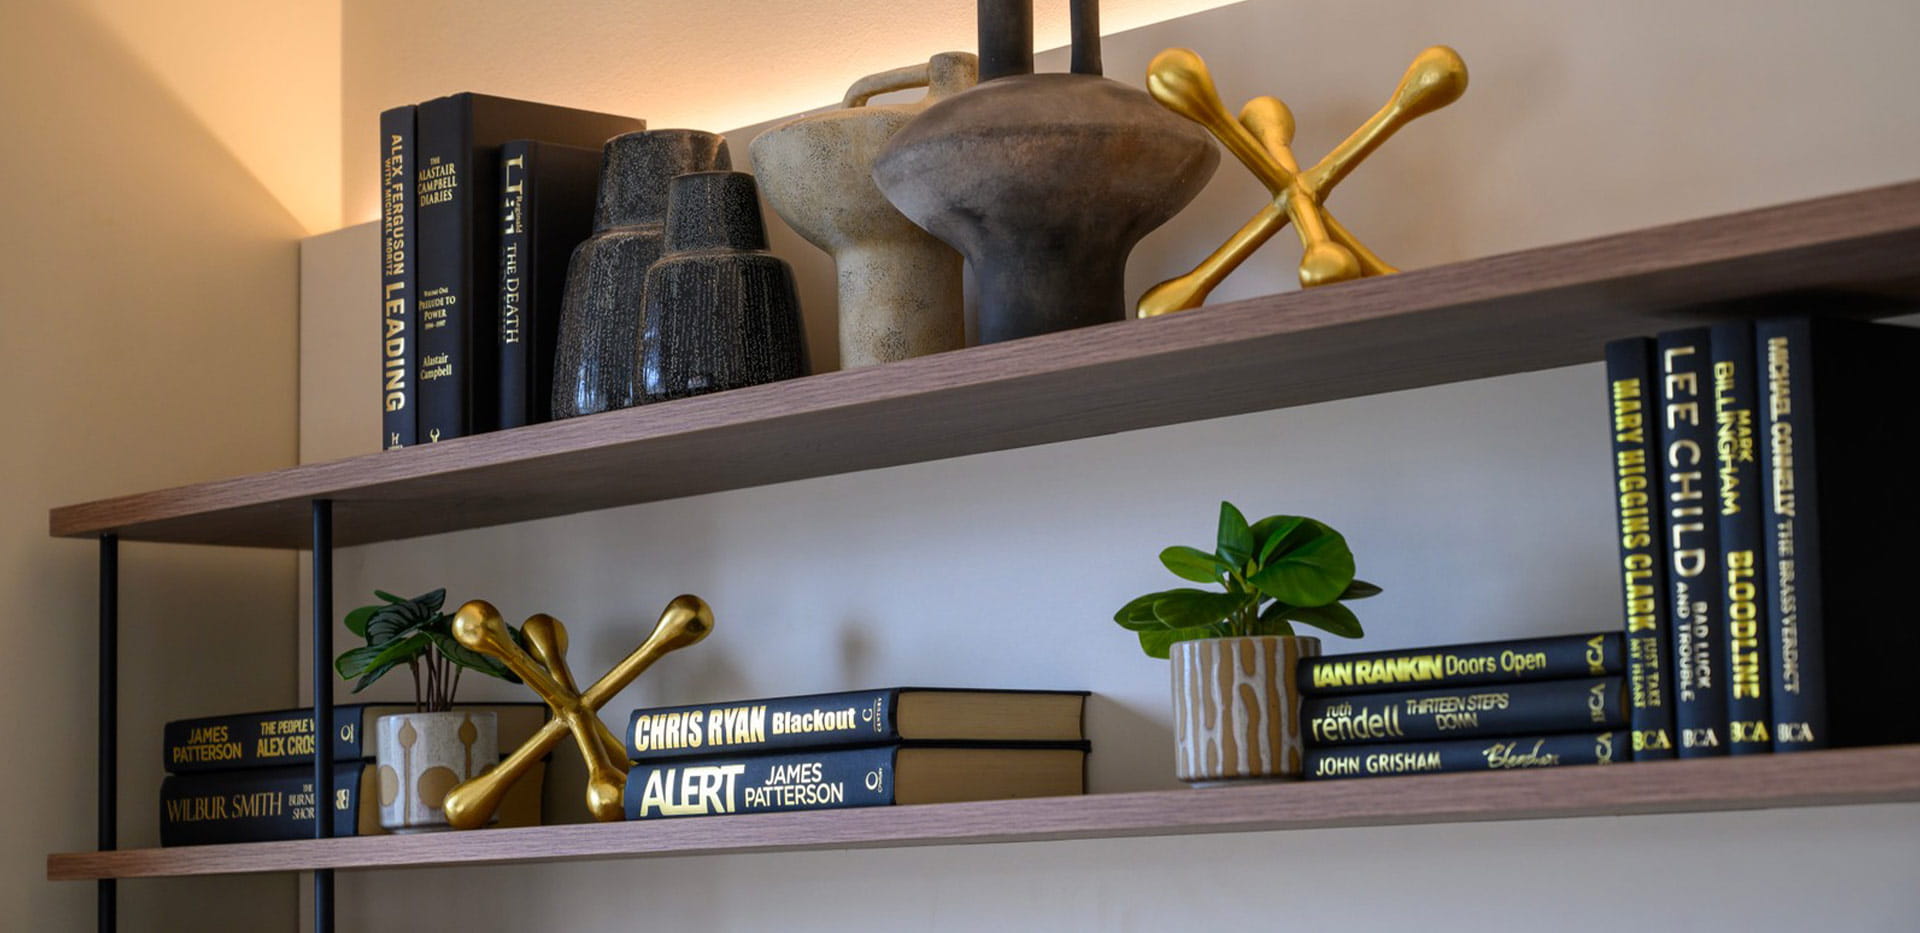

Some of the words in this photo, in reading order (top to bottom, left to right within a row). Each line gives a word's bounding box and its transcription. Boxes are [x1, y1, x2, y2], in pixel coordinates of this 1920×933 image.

[391, 134, 403, 177] ALEX
[419, 162, 456, 182] ALASTAIR
[418, 175, 458, 194] CAMPBELL
[420, 188, 453, 207] DIARIES
[392, 182, 405, 276] FERGUSON
[385, 238, 393, 277] MORITZ
[506, 242, 517, 275] THE
[424, 308, 447, 320] POWER
[445, 295, 456, 305] TO
[506, 278, 520, 345] DEATH
[385, 281, 405, 412] LEADING
[423, 352, 449, 367] Alastair
[420, 364, 452, 380] Campbell
[1664, 346, 1699, 430] LEE
[1768, 336, 1791, 422] MICHAEL
[1613, 378, 1644, 443] MARY
[1714, 361, 1741, 516] BILLINGHAM
[1737, 409, 1753, 462] MARK
[1771, 422, 1796, 517] CONNELLY
[1617, 449, 1651, 549] HIGGINS
[1669, 439, 1706, 577] CHILD
[1777, 519, 1794, 557] THE
[1624, 554, 1656, 633] CLARK
[1676, 581, 1690, 619] AND
[1779, 559, 1797, 614] BRASS
[1692, 601, 1709, 639] BAD
[1727, 550, 1760, 699] BLOODLINE
[1446, 654, 1497, 676] Doors
[1501, 650, 1547, 677] Open
[1678, 623, 1695, 702] TROUBLE
[1694, 642, 1711, 688] LUCK
[1781, 612, 1800, 695] VERDICT
[1313, 662, 1354, 688] IAN
[1355, 655, 1443, 685] RANKIN
[1326, 702, 1353, 718] ruth
[1406, 695, 1467, 716] THIRTEEN
[1468, 692, 1510, 711] STEPS
[187, 725, 229, 745] JAMES
[260, 721, 277, 736] THE
[278, 718, 309, 734] PEOPLE
[634, 709, 703, 752] CHRIS
[708, 705, 767, 746] RYAN
[772, 707, 856, 735] Blackout
[1312, 704, 1404, 742] rendell
[1435, 713, 1478, 731] DOWN
[1682, 728, 1719, 748] BCA
[1729, 720, 1769, 743] BCA
[1777, 722, 1814, 743] BCA
[173, 742, 243, 763] PATTERSON
[256, 736, 286, 758] ALEX
[286, 734, 315, 757] CROS
[1632, 728, 1671, 751] BCA
[765, 763, 822, 785] JAMES
[1316, 757, 1360, 776] JOHN
[1366, 751, 1442, 774] GRISHAM
[288, 793, 315, 807] BURN
[640, 764, 746, 817] ALERT
[745, 782, 844, 808] PATTERSON
[167, 795, 229, 823] WILBUR
[232, 792, 283, 818] SMITH
[291, 806, 316, 820] SHOR
